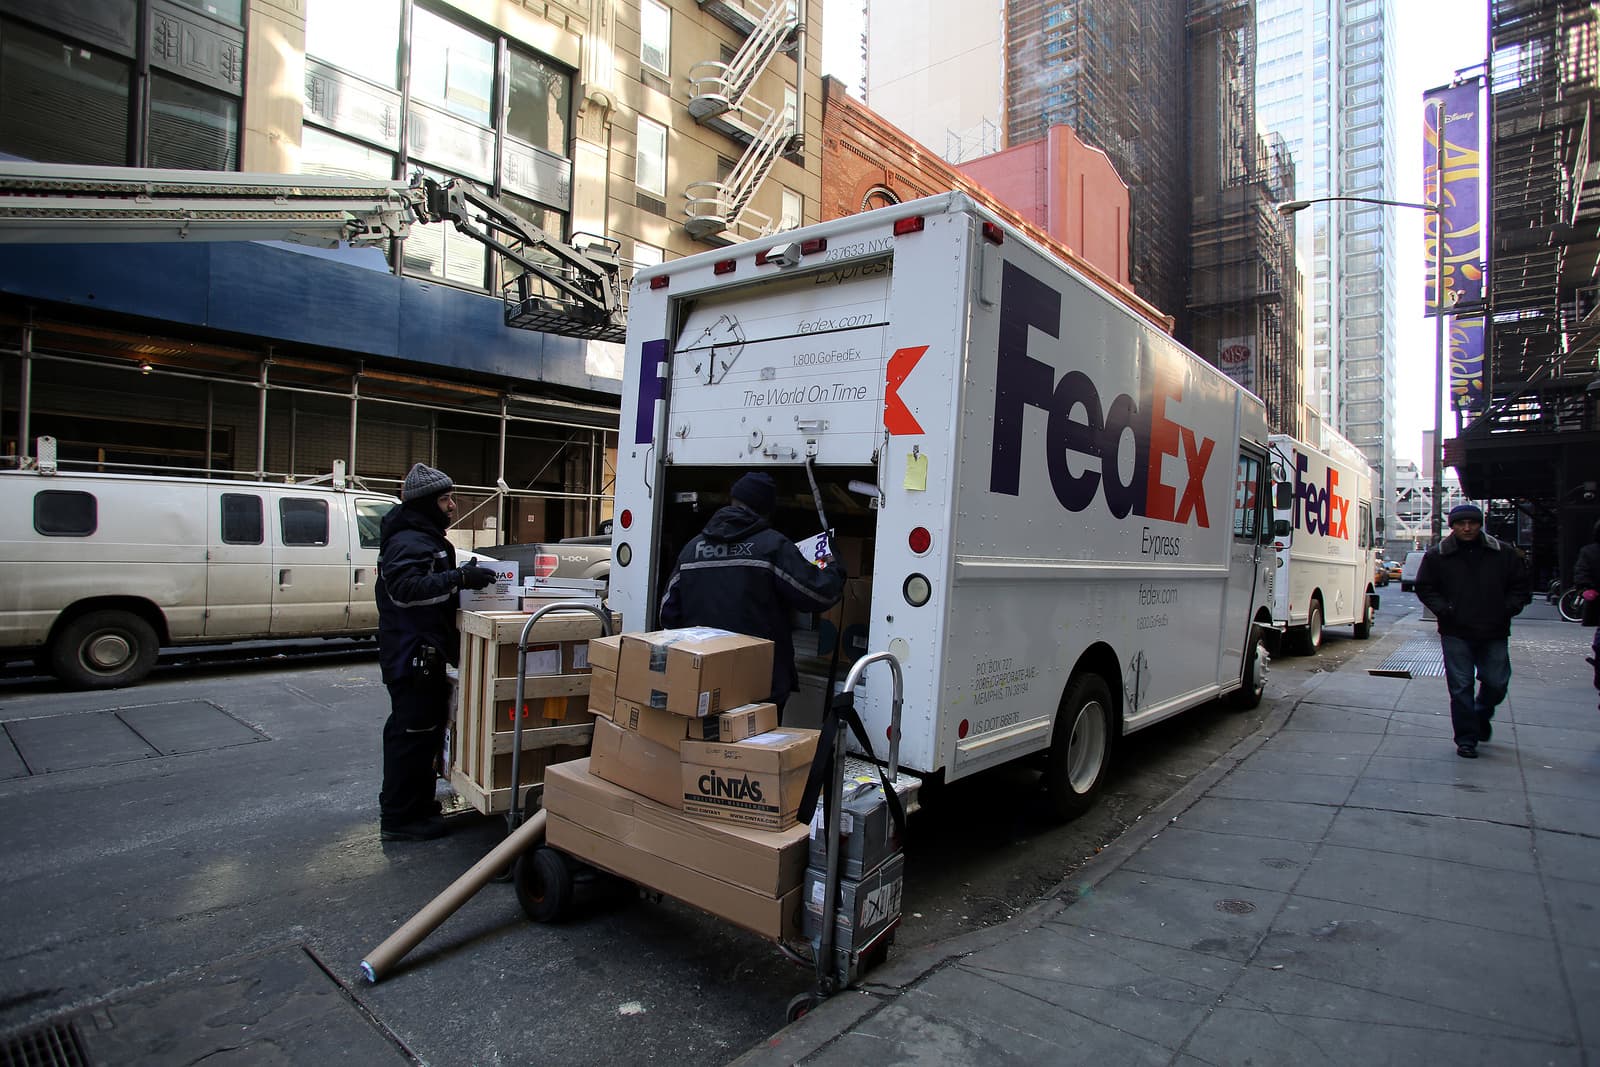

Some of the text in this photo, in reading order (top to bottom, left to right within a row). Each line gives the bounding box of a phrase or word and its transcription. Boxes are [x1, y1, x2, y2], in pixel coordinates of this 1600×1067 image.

[1445, 111, 1473, 124] Disney
[825, 236, 894, 262] 237633 NYC
[797, 313, 873, 334] fedex.com
[793, 348, 861, 366] 1.800.GoFedEx
[743, 383, 867, 406] The World On Time
[990, 259, 1216, 529] FedEx
[1295, 452, 1349, 540] FedEx
[695, 541, 754, 559] FedEx
[1142, 527, 1180, 560] Express
[1139, 583, 1178, 606] fedex.com
[974, 688, 1004, 704] MEMPHIS
[984, 715, 1000, 732] DOT
